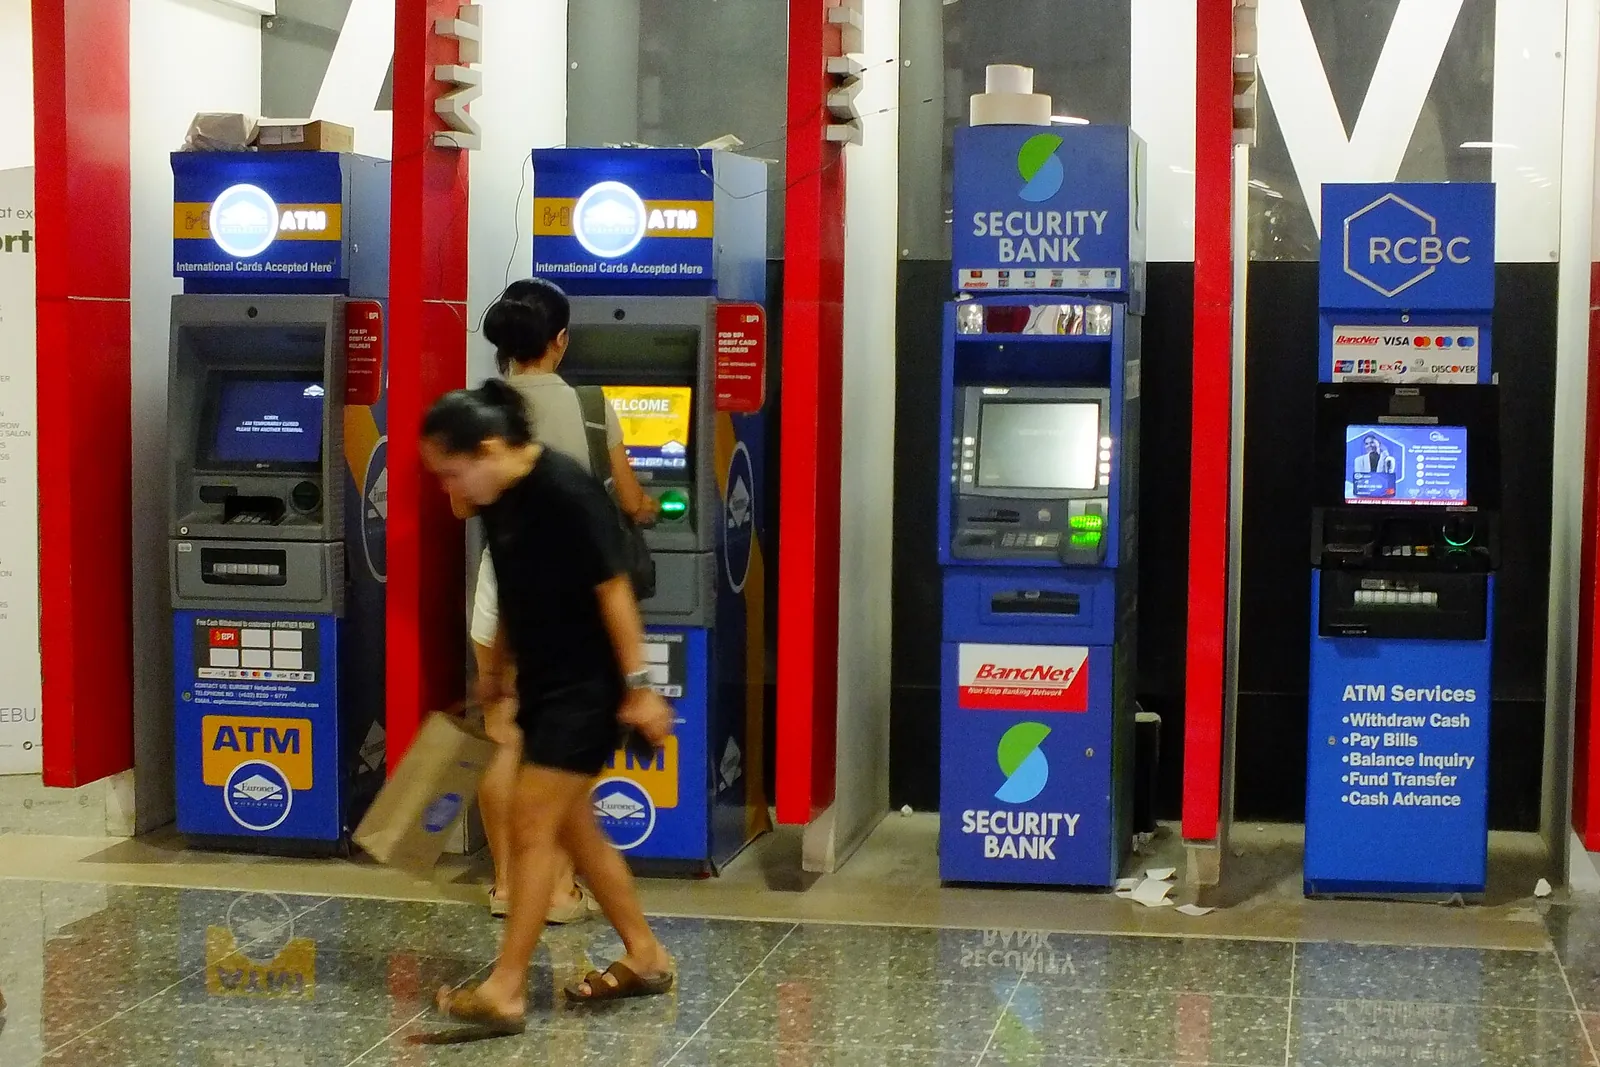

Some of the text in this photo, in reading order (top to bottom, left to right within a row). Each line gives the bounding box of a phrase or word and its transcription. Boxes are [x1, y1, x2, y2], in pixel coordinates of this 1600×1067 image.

[280, 210, 327, 232] ATM
[647, 208, 698, 231] ATM
[972, 210, 1108, 236] SECURITY
[998, 237, 1081, 263] BANK
[1369, 236, 1471, 264] RCBC
[176, 261, 332, 274] International Cards Accepted Here
[536, 262, 703, 275] International Cards Accepted Here
[1335, 335, 1410, 346] BancNet VISA
[1431, 365, 1476, 373] DISCOVER
[221, 632, 235, 640] BPI
[975, 663, 1075, 683] BancNet
[1002, 687, 1031, 697] Banking
[1032, 688, 1063, 697] Network
[1341, 684, 1477, 703] ATM Services
[1349, 712, 1471, 728] Withdraw Cash
[212, 725, 301, 755] ATM
[1349, 732, 1418, 749] Pay Bills
[1349, 752, 1475, 770] Balance Inquiry
[242, 783, 275, 793] Euronet
[1349, 772, 1458, 787] Fund Transfer
[601, 800, 636, 811] Euronet
[1349, 791, 1461, 807] Cash Advance
[961, 809, 1081, 836] SECURITY
[984, 834, 1056, 860] BANK
